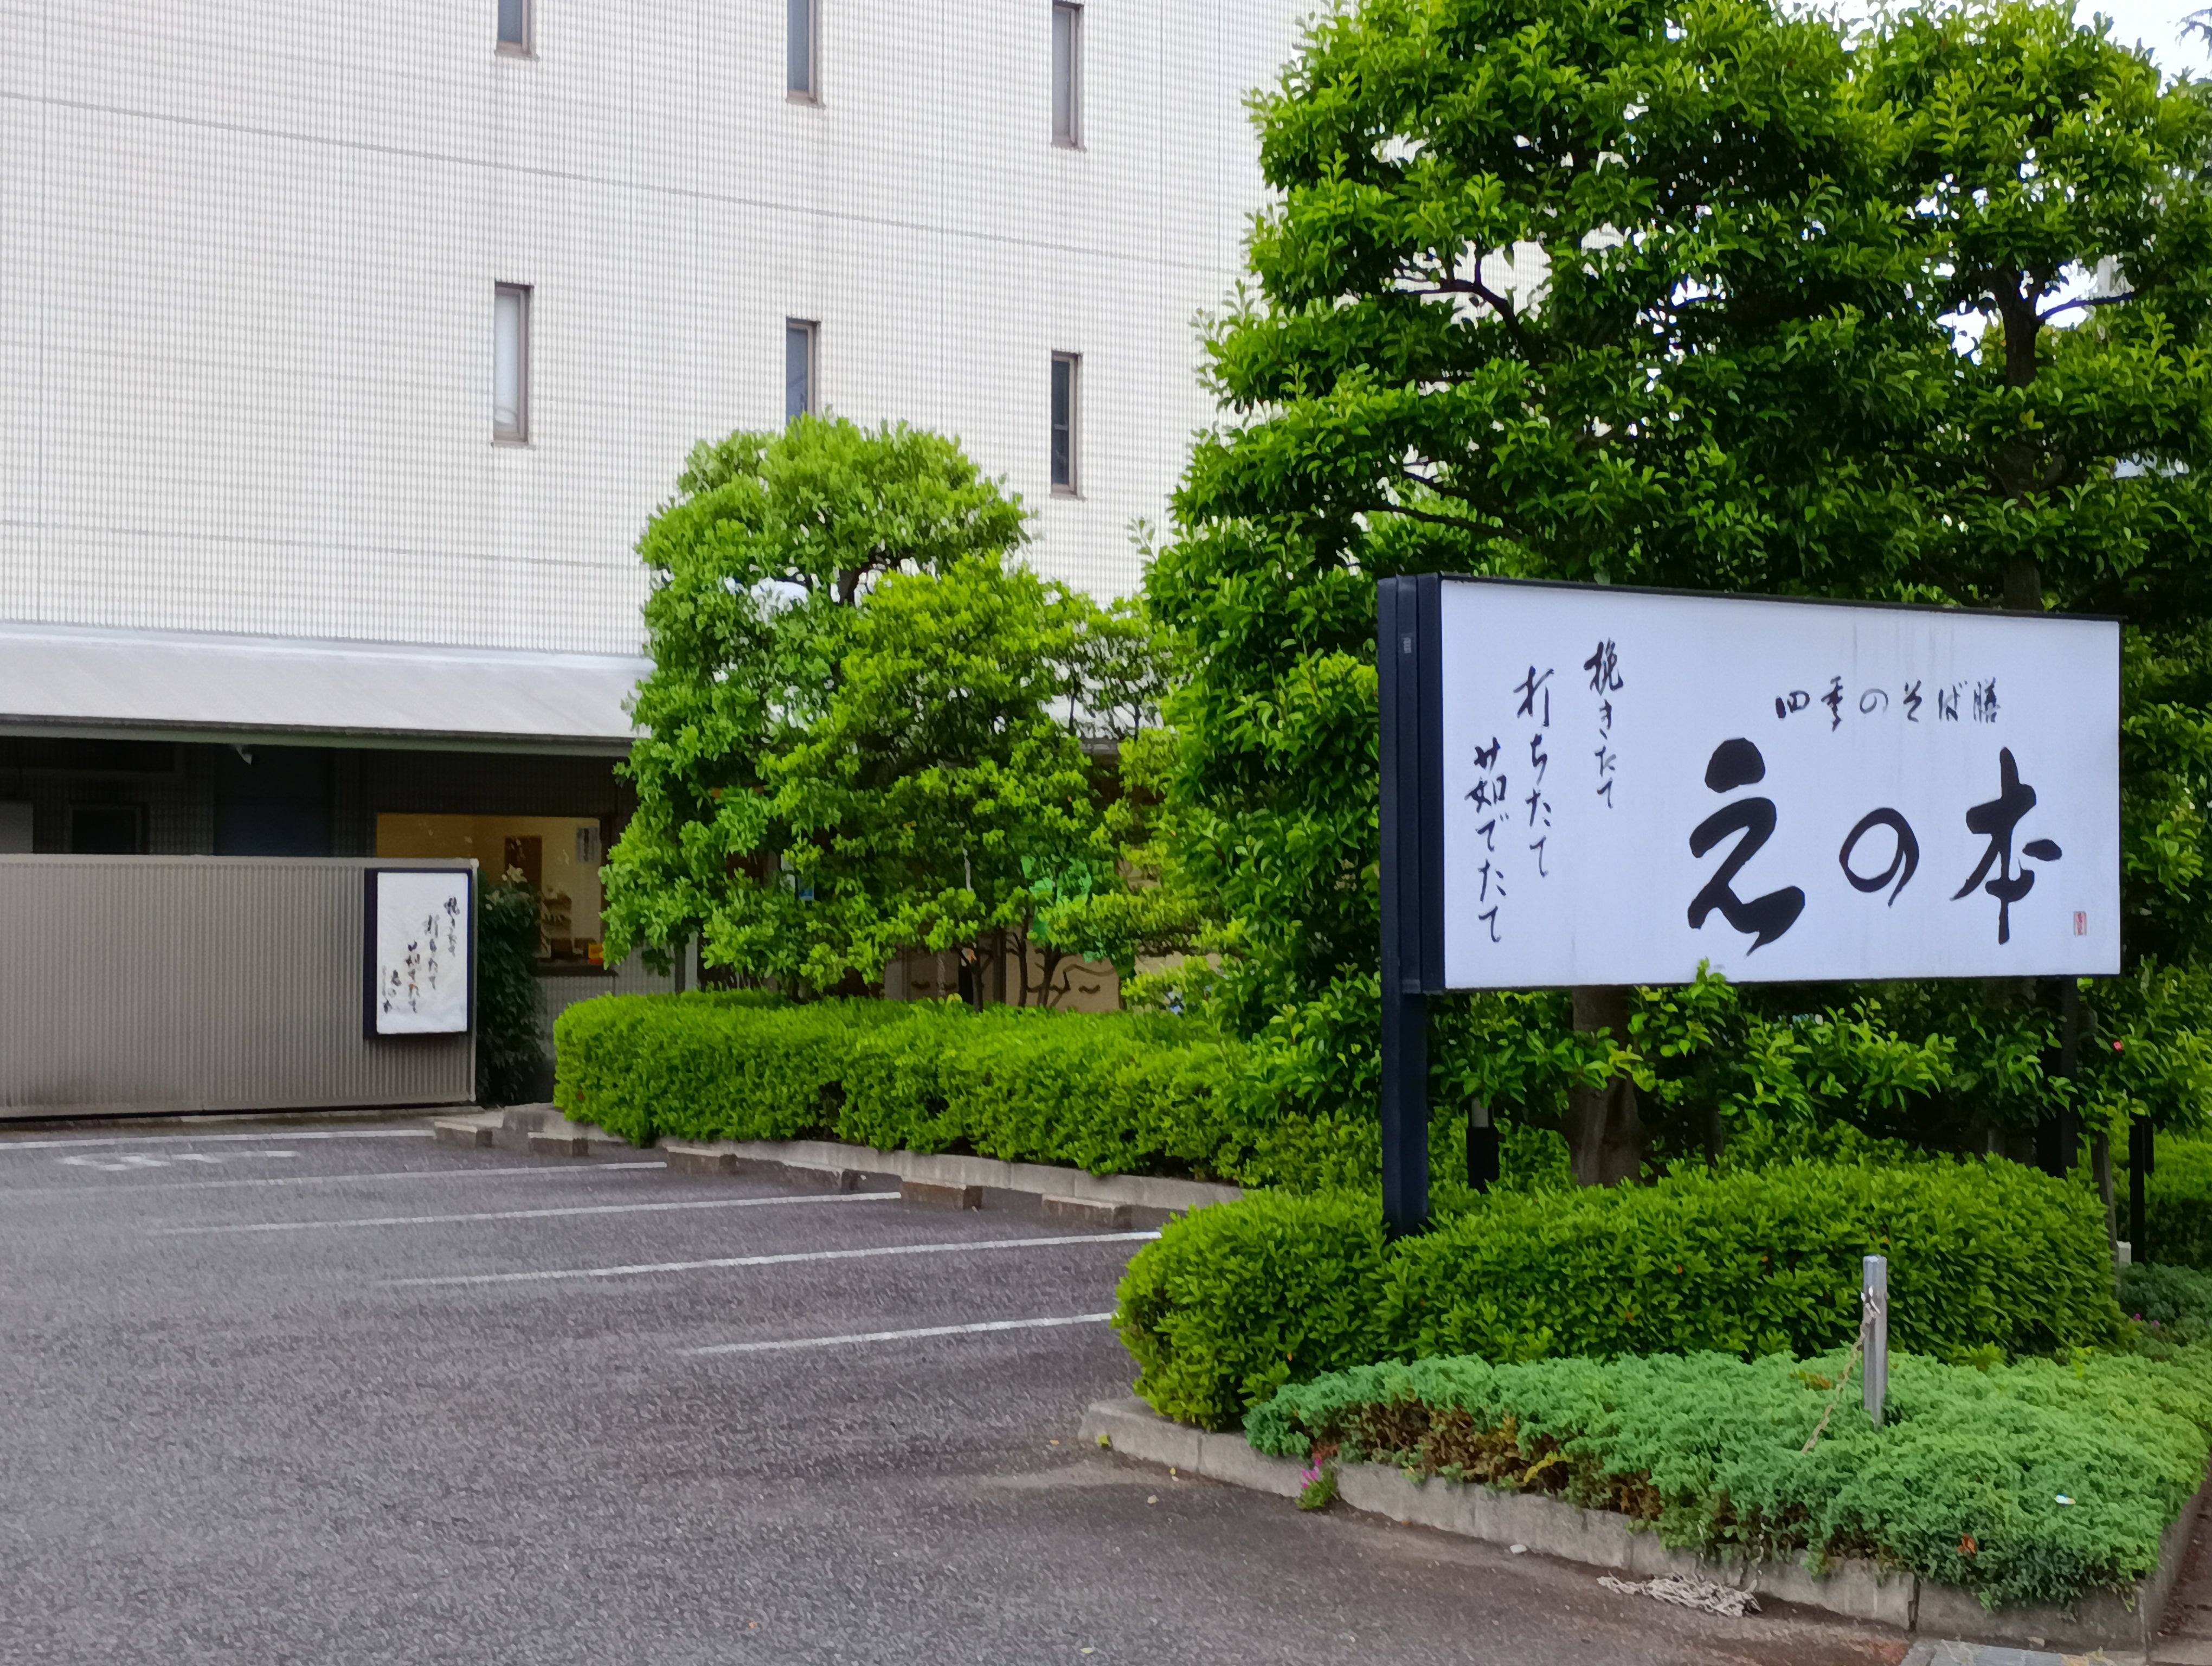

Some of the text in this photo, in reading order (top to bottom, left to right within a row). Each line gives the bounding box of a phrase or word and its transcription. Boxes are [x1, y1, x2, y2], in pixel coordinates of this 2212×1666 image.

[1513, 665, 1554, 877] 打ちたて
[1584, 637, 1623, 809] 挽きたて
[1464, 736, 1509, 943] 茹でたて
[1688, 738, 2062, 957] えの本
